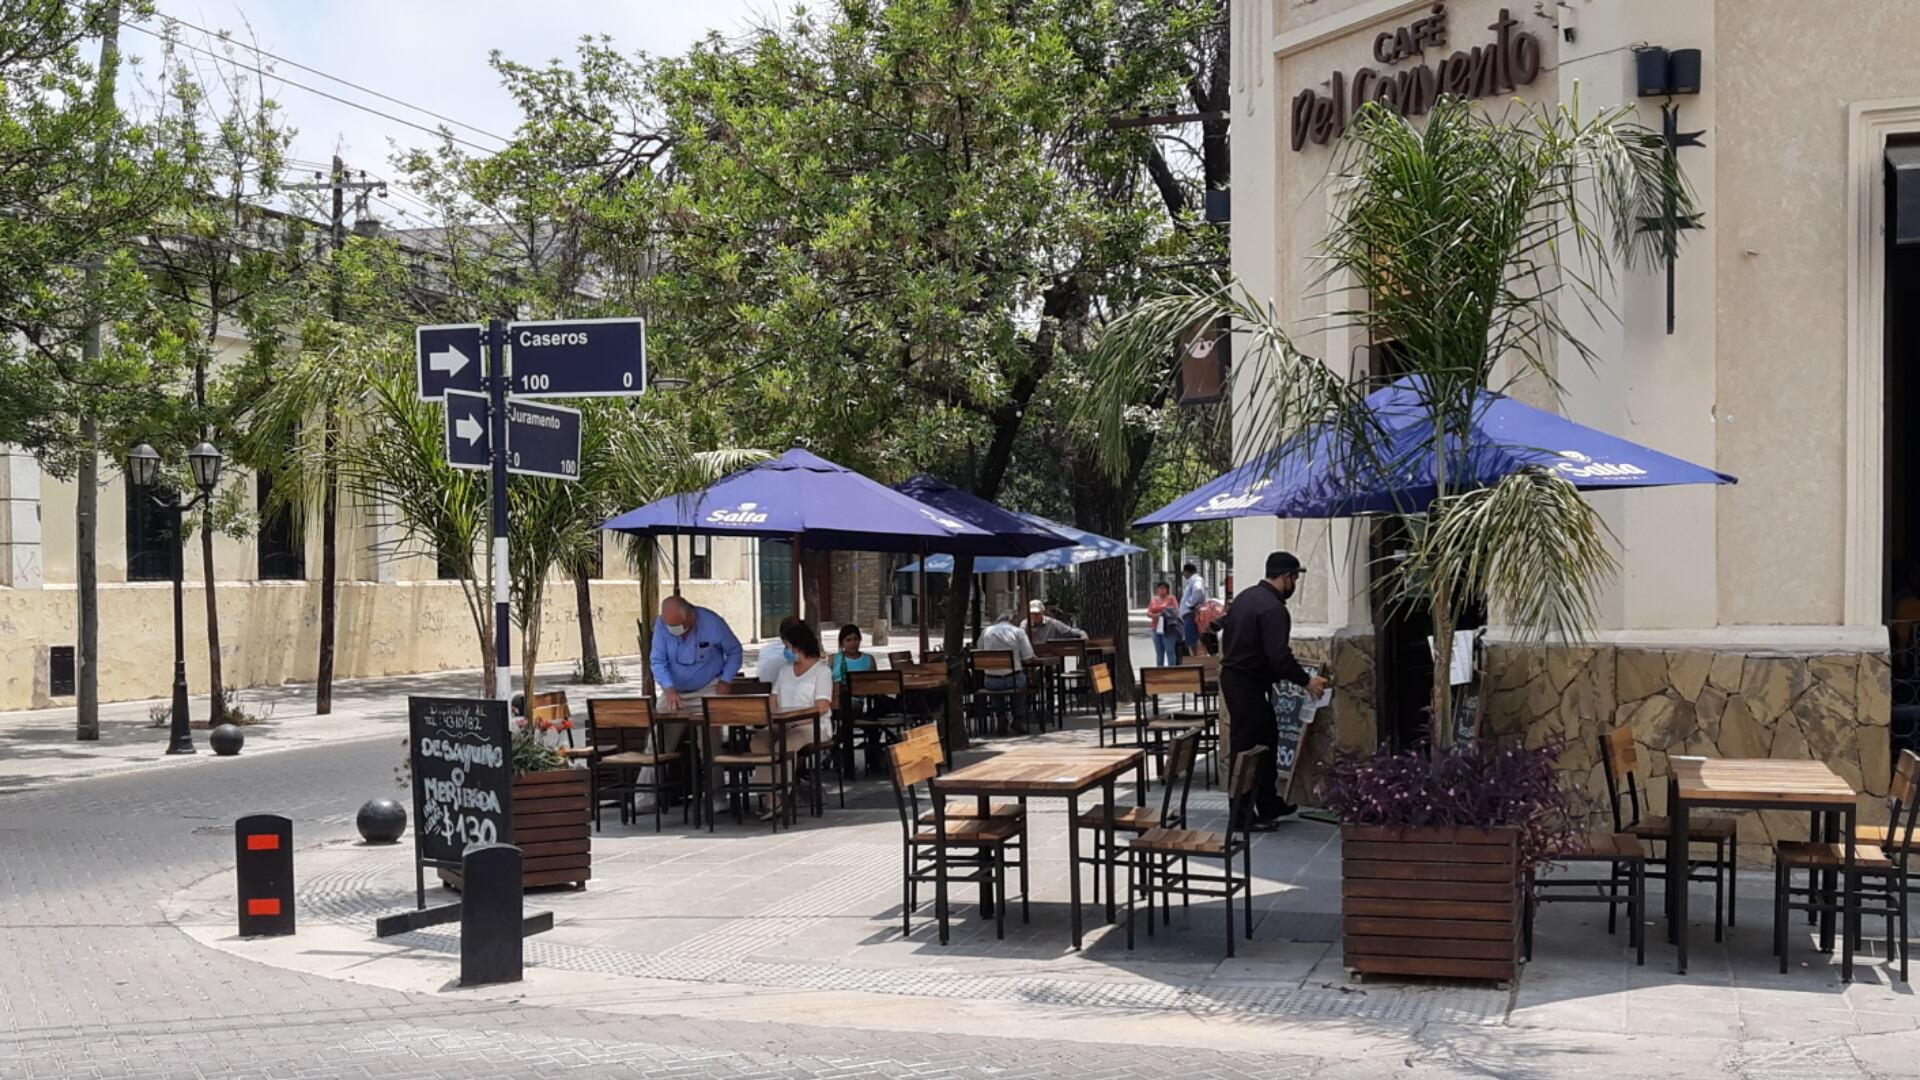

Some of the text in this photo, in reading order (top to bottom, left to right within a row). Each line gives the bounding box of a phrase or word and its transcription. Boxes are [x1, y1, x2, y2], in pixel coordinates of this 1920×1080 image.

[1373, 4, 1447, 63] CAFÉ
[1291, 8, 1540, 151] Del Convento
[519, 331, 588, 347] Caseros
[521, 372, 633, 391] 100 0
[510, 407, 560, 429] Juramento
[513, 452, 577, 475] 0 100
[1557, 462, 1647, 477] Salta
[706, 509, 768, 523] Salta
[421, 737, 503, 773] DESAYUNO
[441, 804, 497, 846] $130
